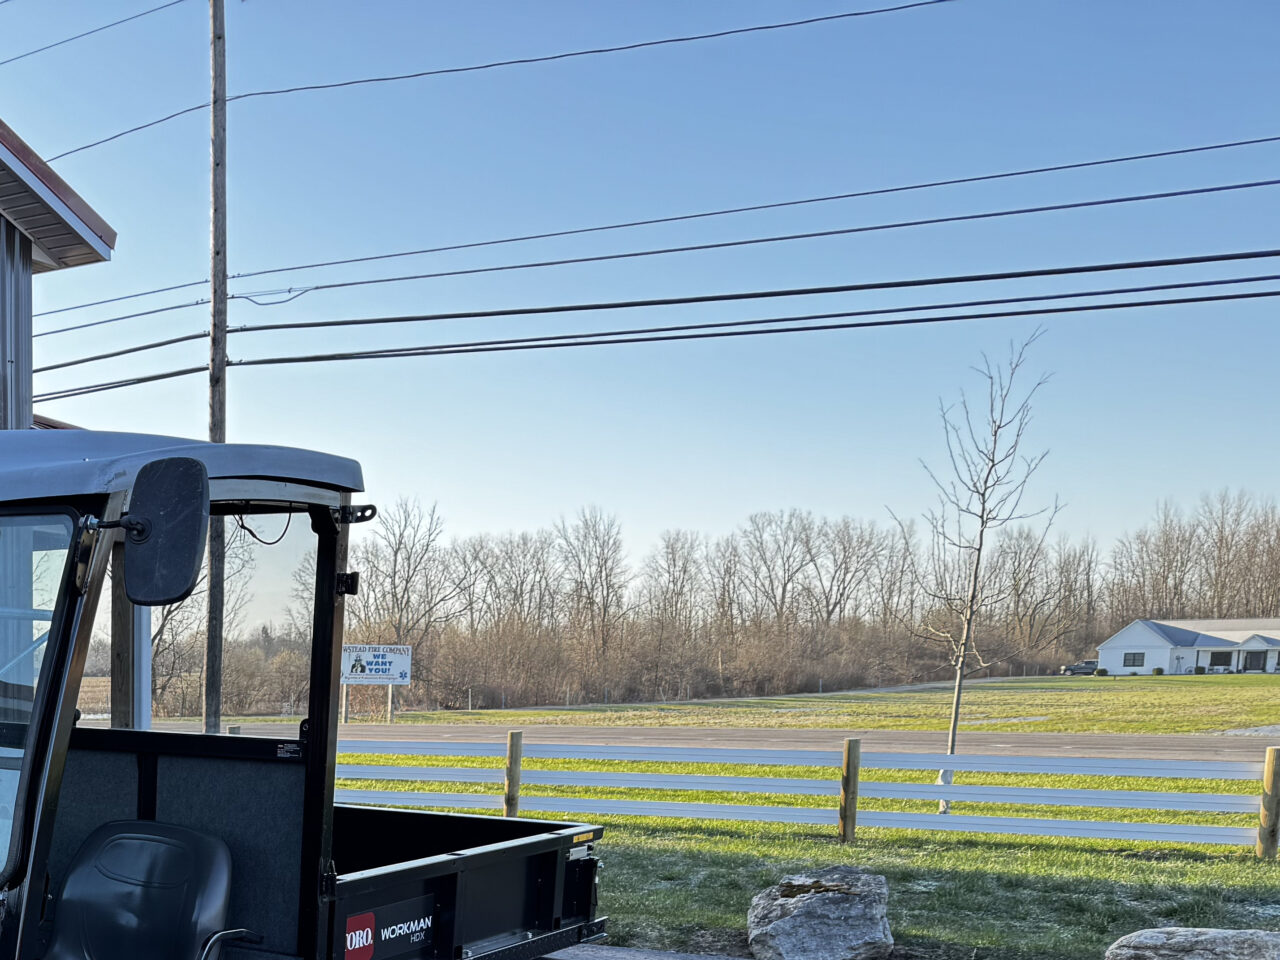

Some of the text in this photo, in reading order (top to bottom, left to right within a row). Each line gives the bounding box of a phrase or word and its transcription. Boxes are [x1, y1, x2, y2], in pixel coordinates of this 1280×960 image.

[382, 647, 410, 656] COMPANY
[345, 916, 432, 951] ORO WORKMAN
[410, 931, 426, 943] HDX
